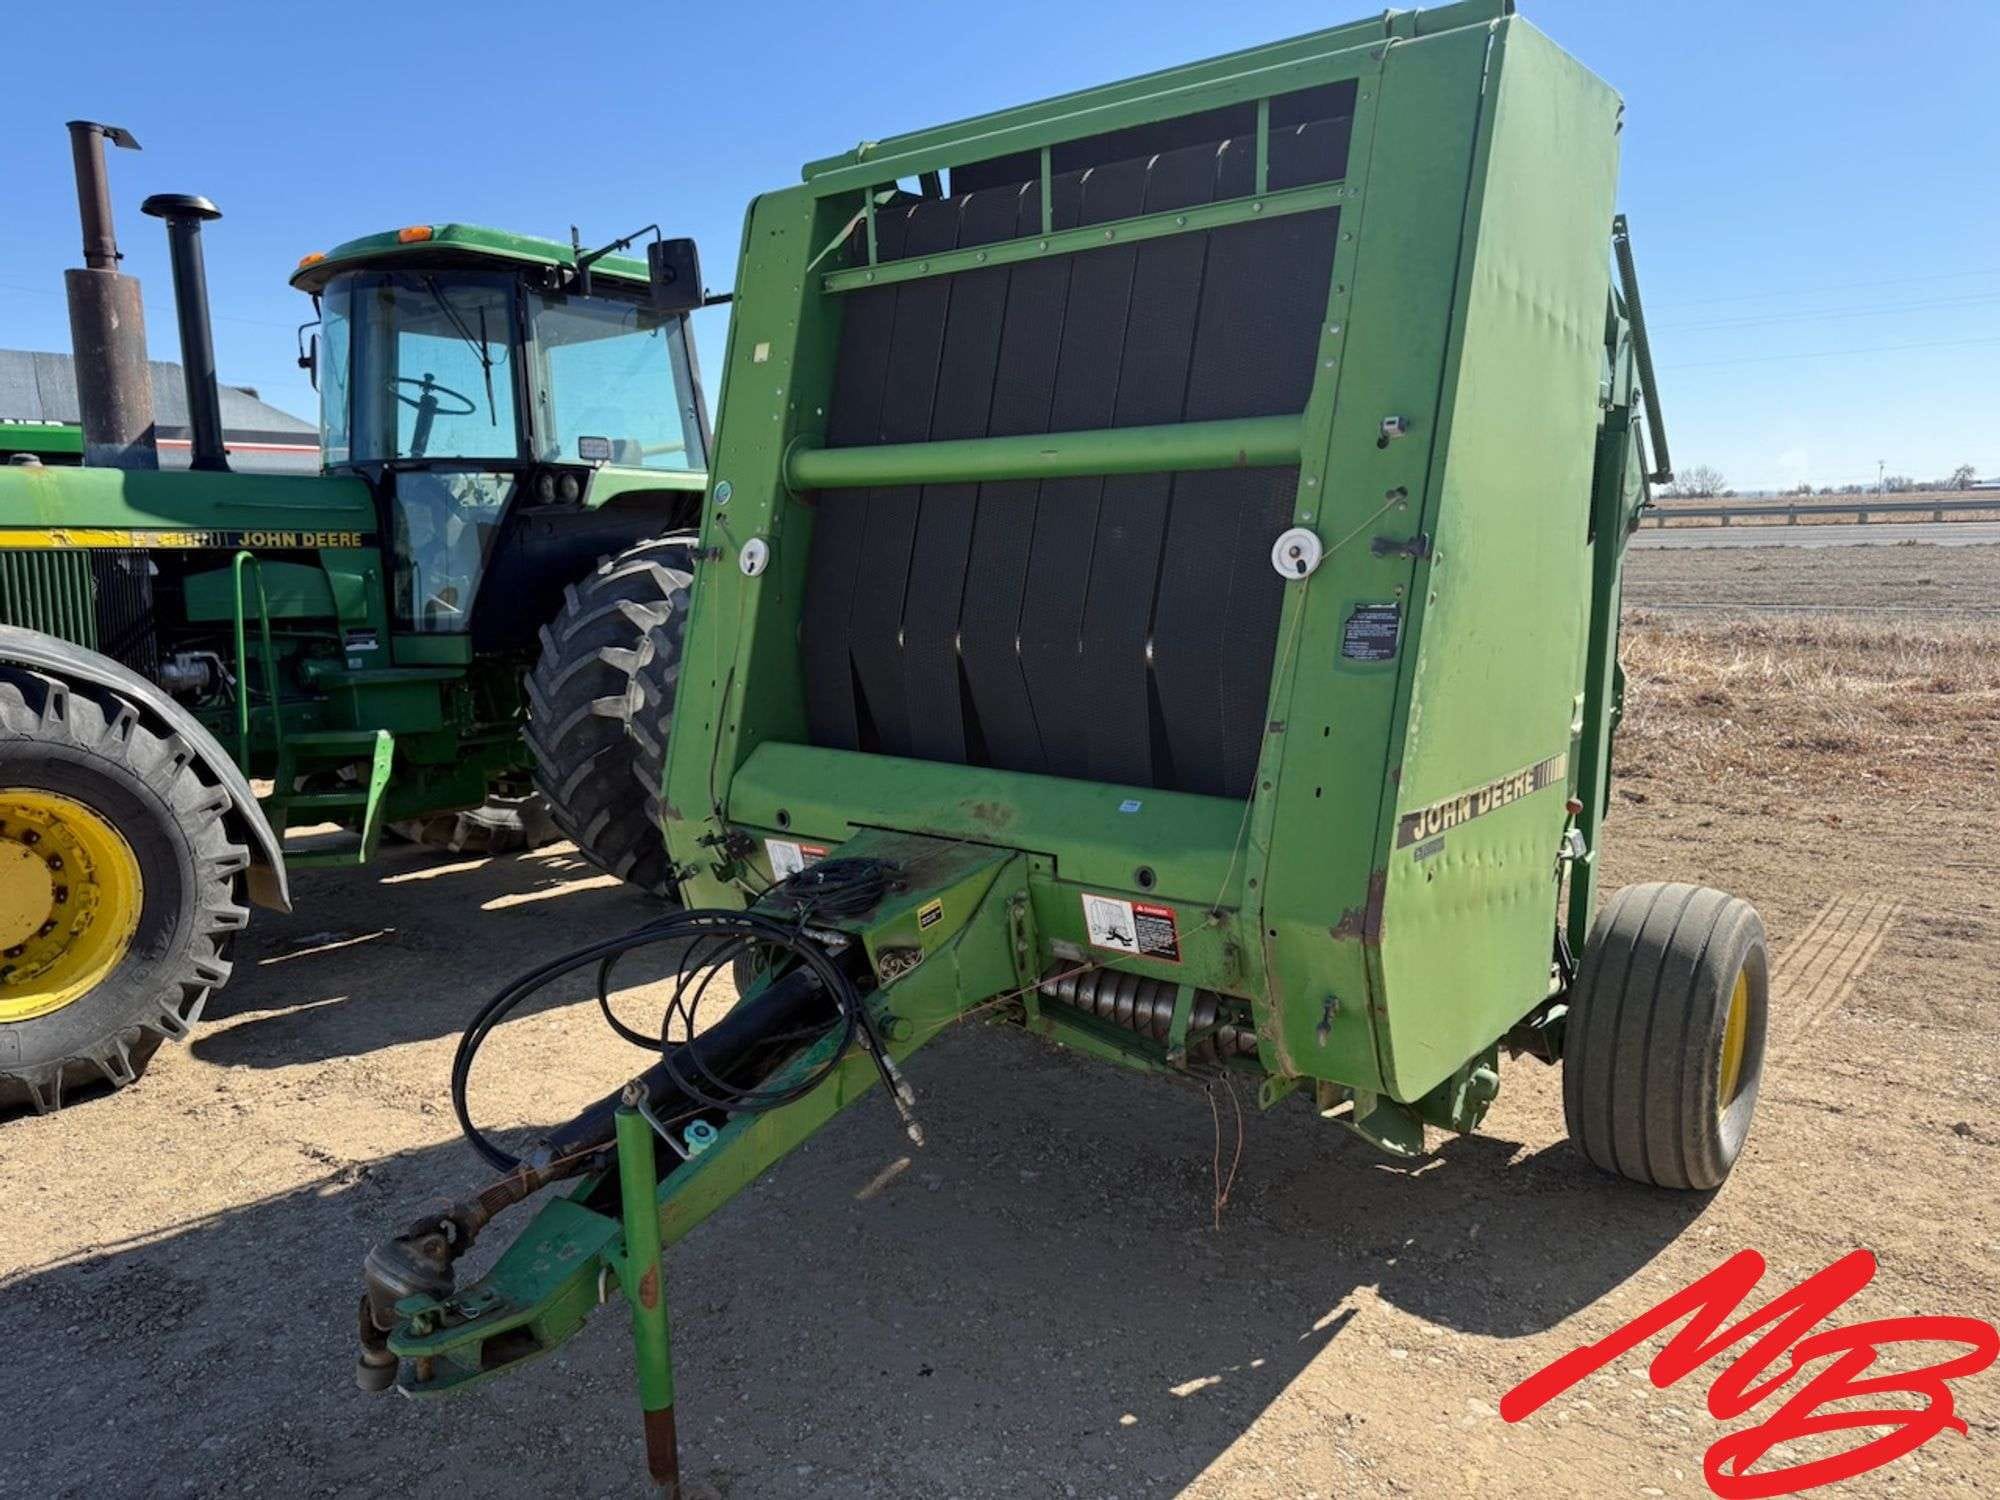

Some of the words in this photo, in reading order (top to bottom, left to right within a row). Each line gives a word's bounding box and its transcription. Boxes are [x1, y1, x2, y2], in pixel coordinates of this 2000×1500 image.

[238, 531, 297, 547] JOHN
[302, 532, 362, 547] DEERE
[1413, 796, 1471, 841] JOHN
[1477, 771, 1534, 815] DEERE
